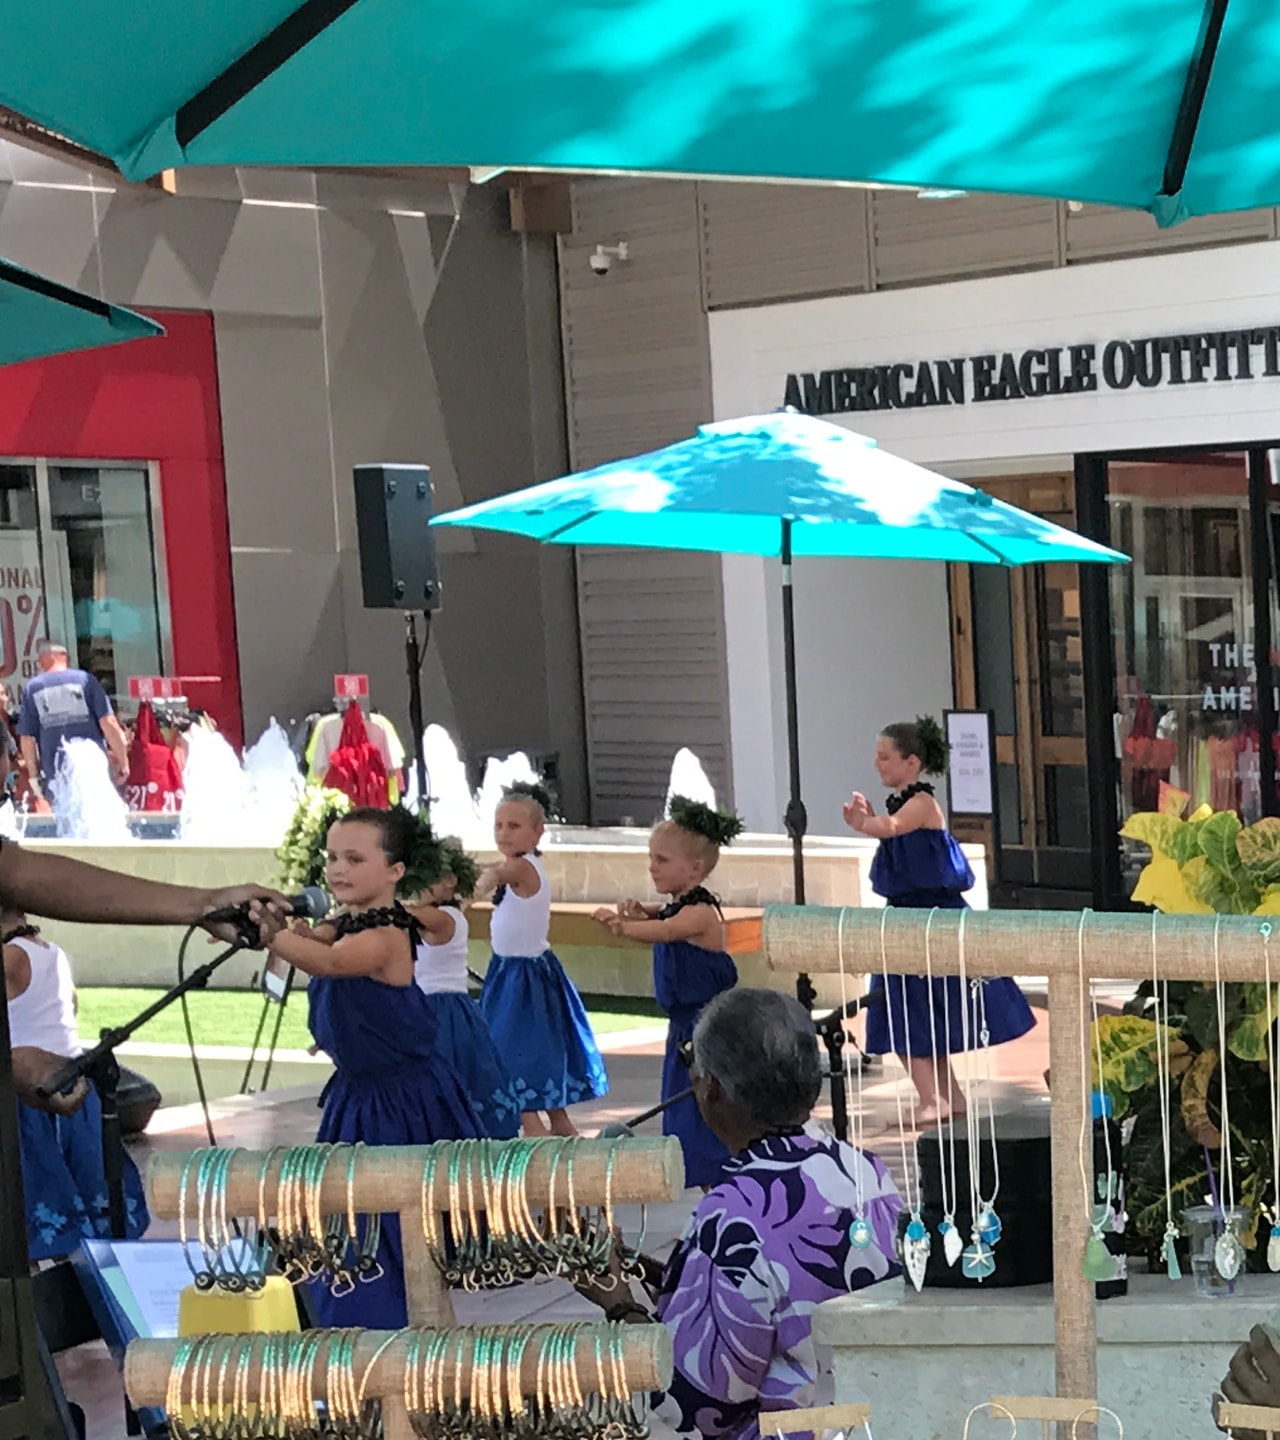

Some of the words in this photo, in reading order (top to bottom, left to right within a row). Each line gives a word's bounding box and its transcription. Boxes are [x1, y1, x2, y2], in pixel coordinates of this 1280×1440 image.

[783, 358, 967, 415] AMERICAN
[968, 343, 1098, 403] EAGLE
[1208, 642, 1255, 668] THE
